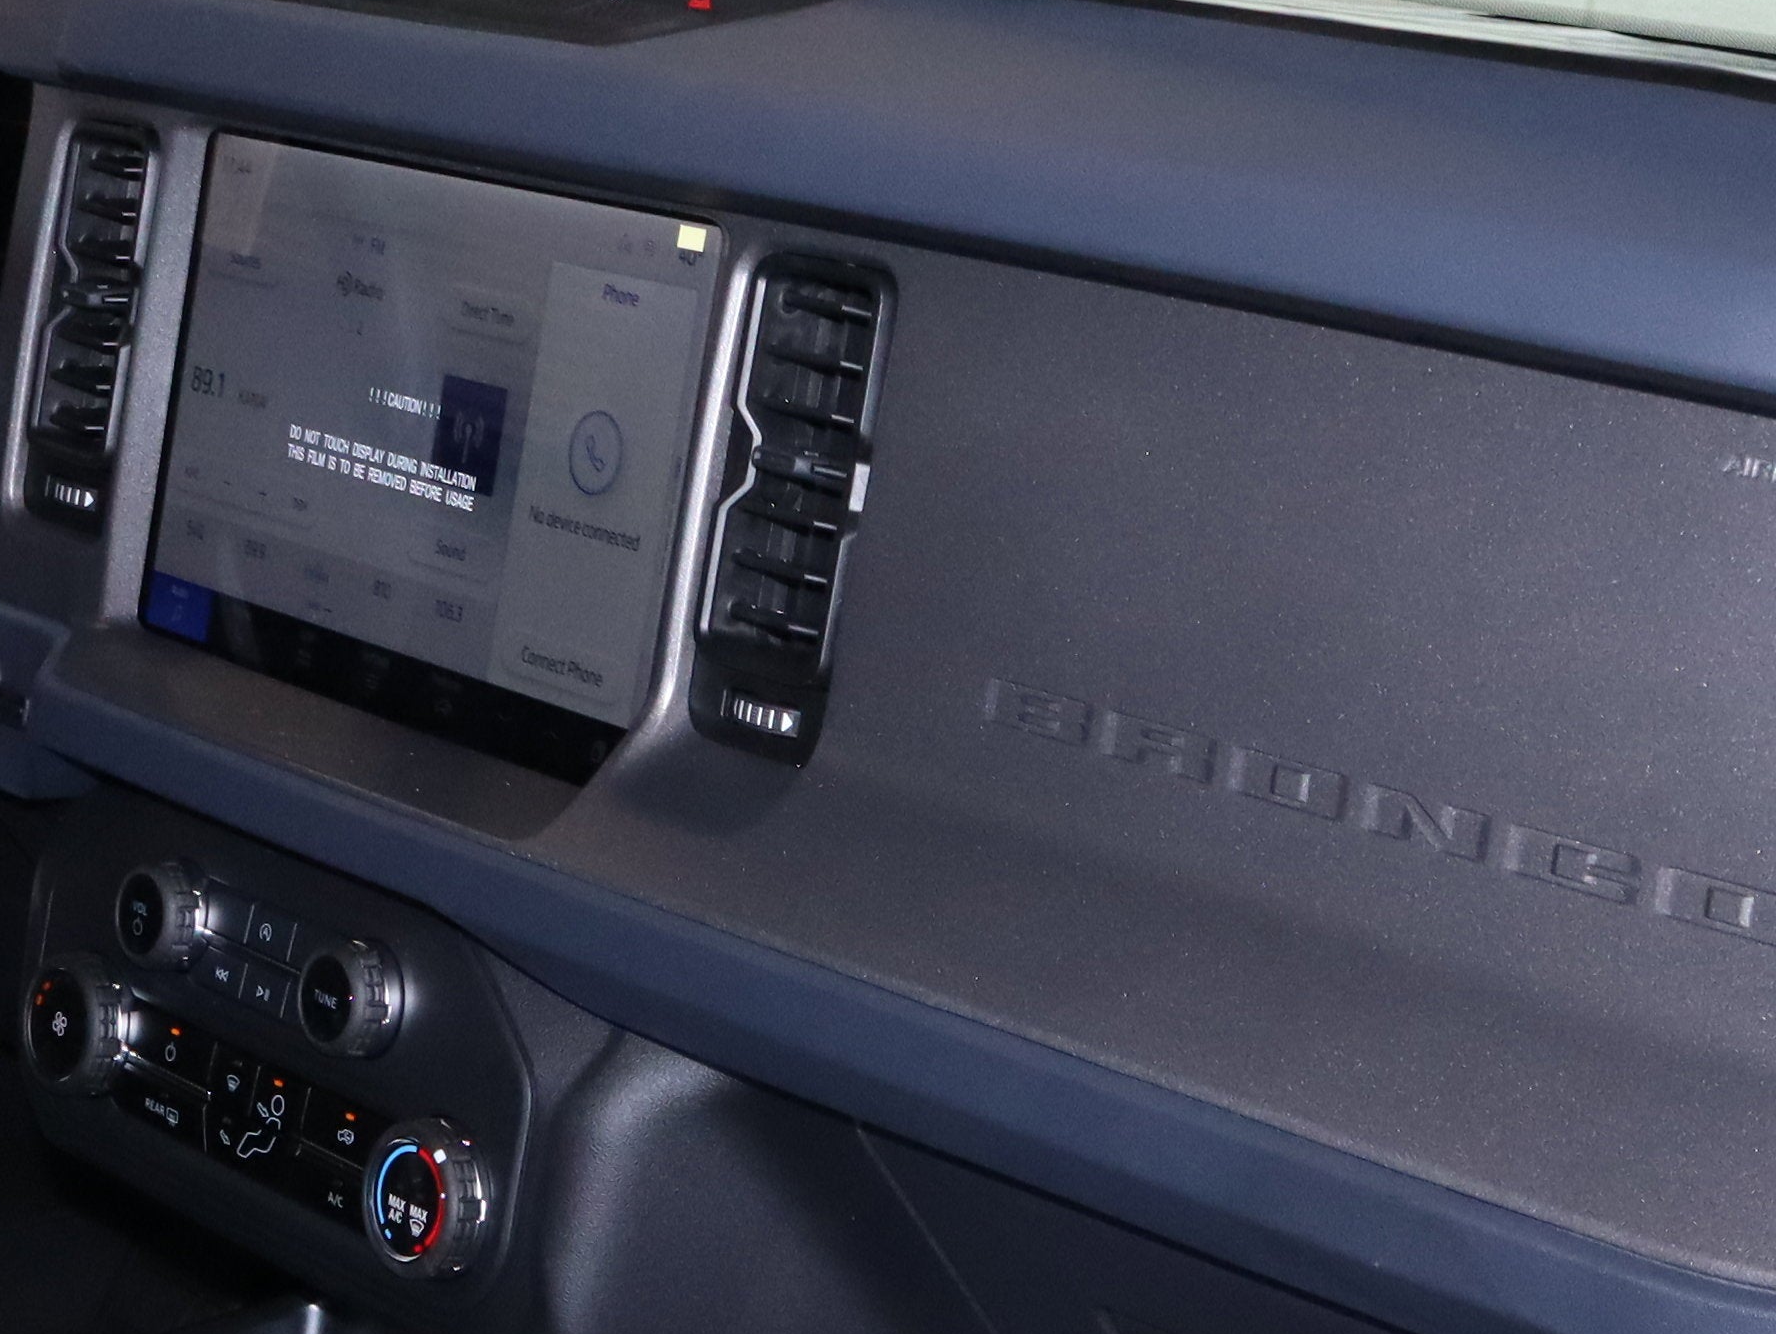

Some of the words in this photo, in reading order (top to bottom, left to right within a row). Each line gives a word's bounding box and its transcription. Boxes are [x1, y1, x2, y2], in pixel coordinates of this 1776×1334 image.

[600, 282, 641, 310] Phone
[188, 365, 227, 400] 89.1
[288, 424, 302, 444] DO
[302, 428, 322, 449] NOT
[321, 433, 351, 457] TOUCH
[350, 441, 386, 467] DISPLAY
[385, 450, 419, 476] DURING
[418, 459, 478, 493] INSTALLATION
[285, 443, 305, 464] THIS
[304, 448, 326, 470] FILM
[325, 454, 337, 473] IS
[337, 457, 351, 477] TO
[351, 461, 366, 482] BE
[365, 464, 408, 494] REMOVED
[407, 477, 443, 504] BEFORE
[443, 487, 476, 513] USAGE
[567, 658, 605, 689] Phone
[313, 988, 337, 1010] TUNE
[144, 1097, 165, 1117] REAR
[327, 1190, 344, 1208] A/C
[387, 1192, 405, 1214] MAX
[387, 1206, 403, 1225] A/C
[409, 1202, 427, 1223] MAX
